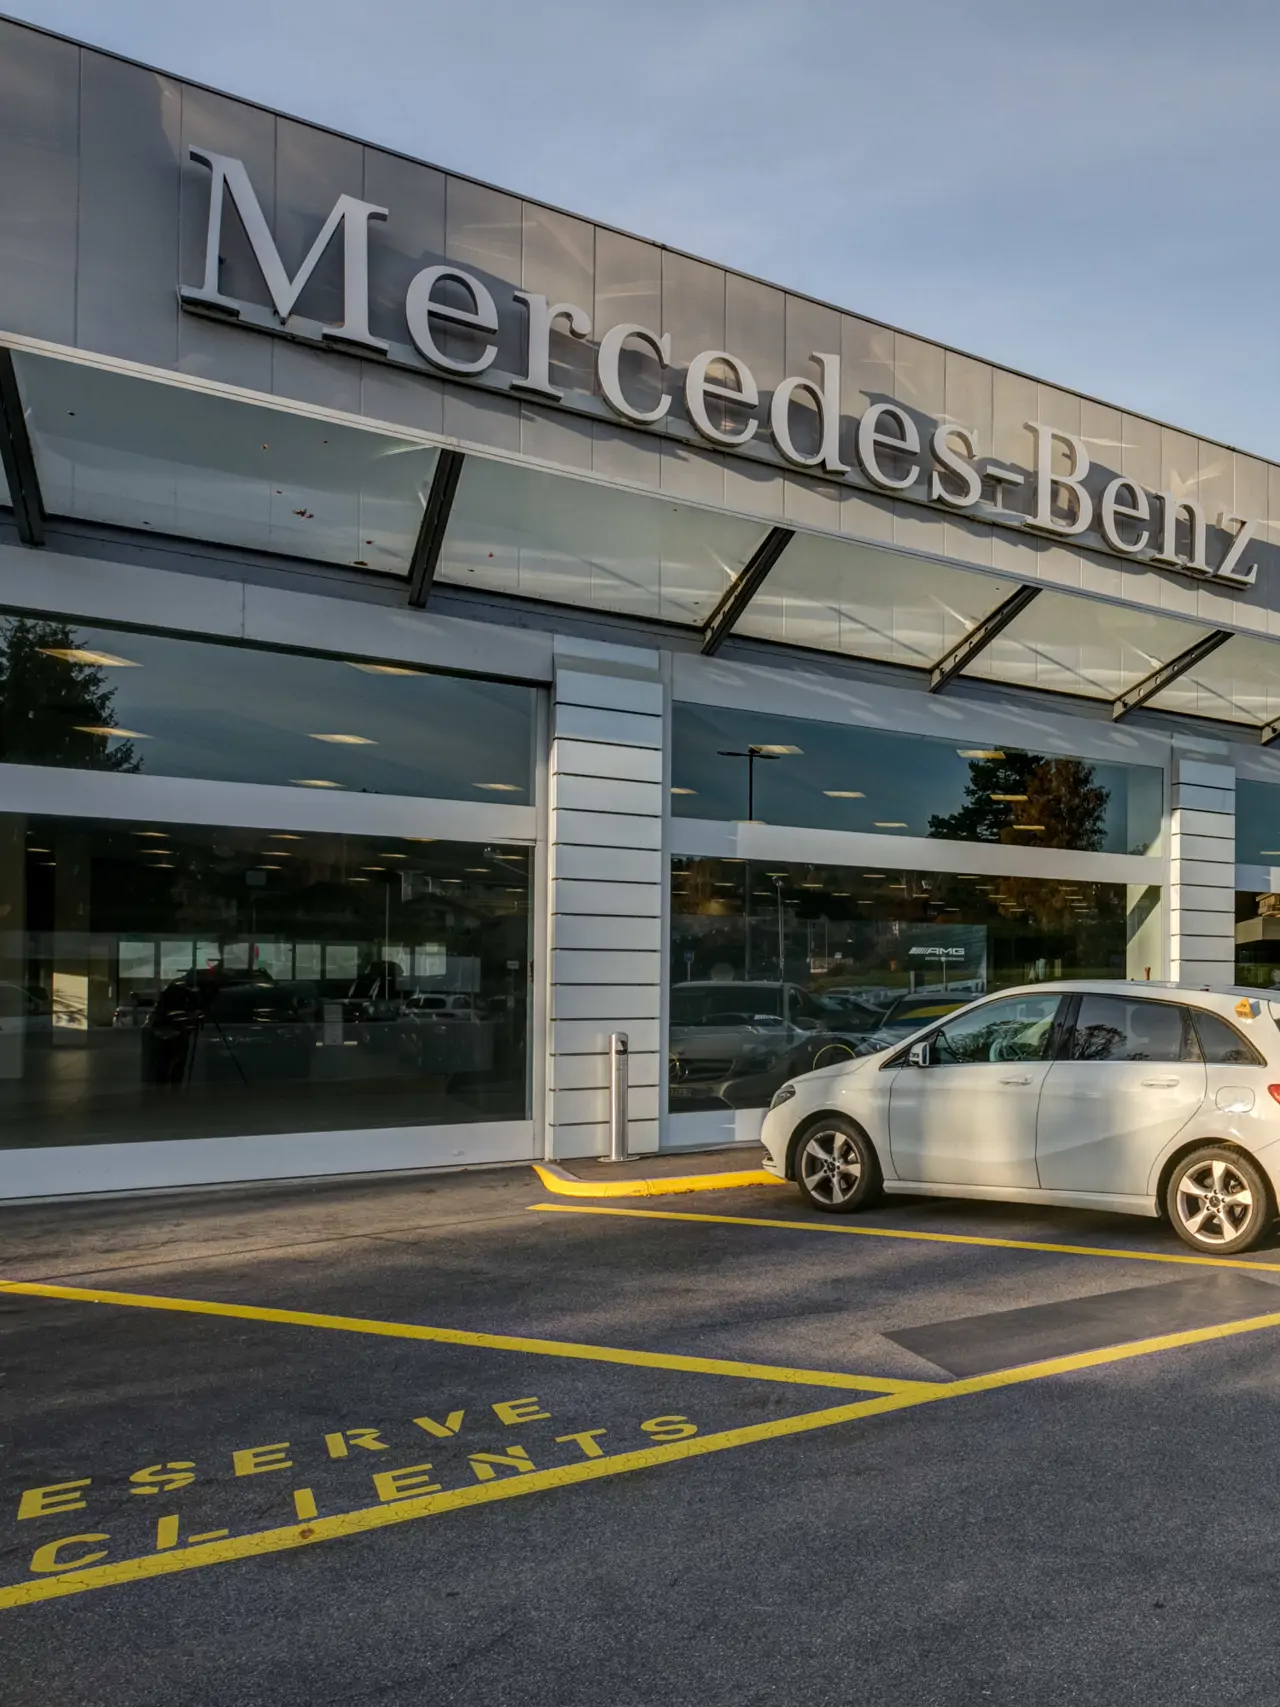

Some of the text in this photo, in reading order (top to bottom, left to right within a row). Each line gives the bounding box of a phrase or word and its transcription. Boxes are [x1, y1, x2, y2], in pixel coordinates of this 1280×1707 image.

[180, 144, 1258, 586] Mercedes-Benz
[926, 947, 965, 955] AMG
[28, 1414, 698, 1573] CLIENTS
